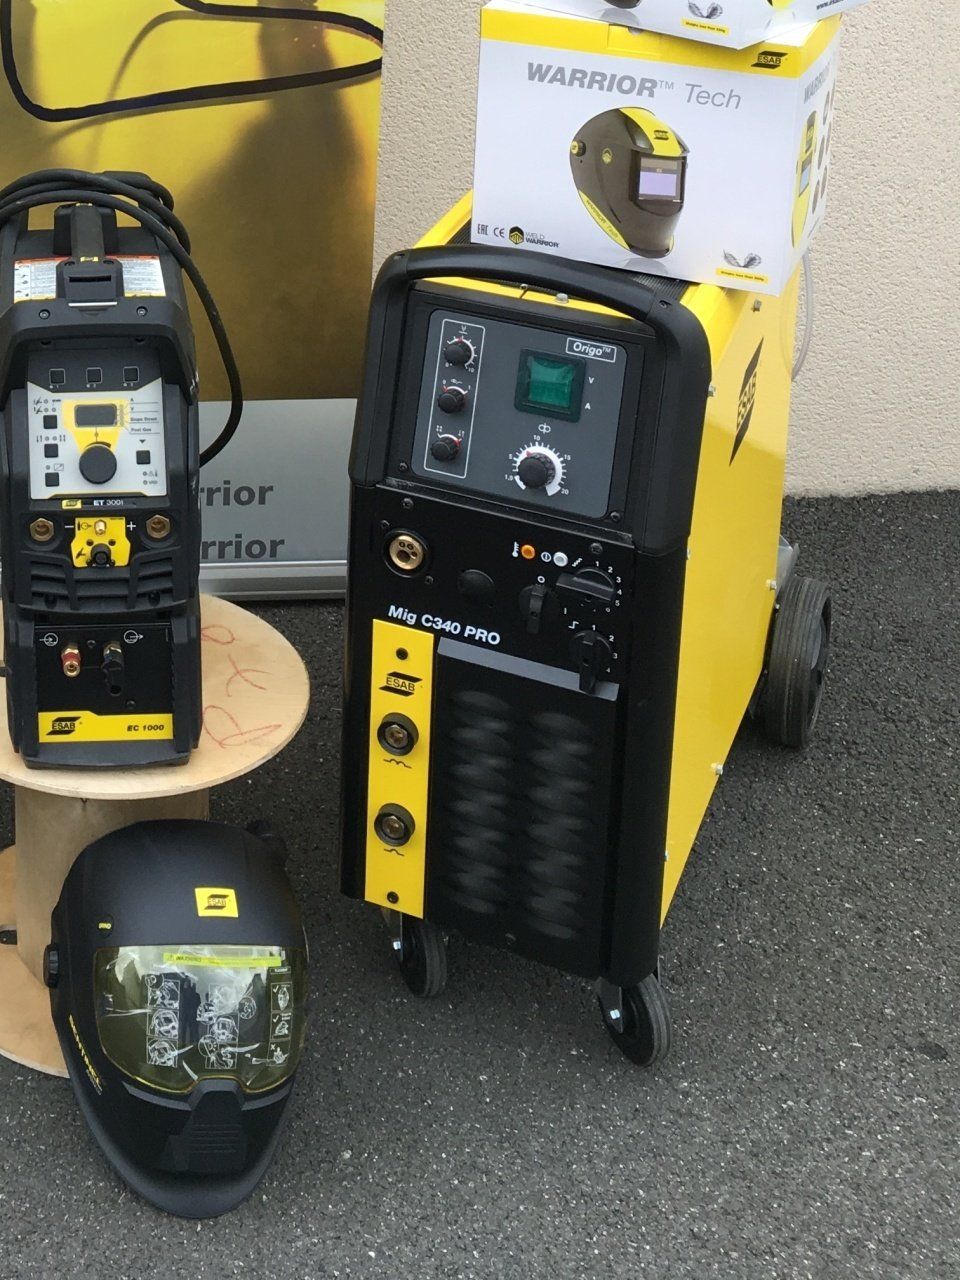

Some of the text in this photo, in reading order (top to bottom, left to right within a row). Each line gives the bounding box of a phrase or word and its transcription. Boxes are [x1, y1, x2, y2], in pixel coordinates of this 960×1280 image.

[757, 54, 782, 65] ESAB
[685, 82, 741, 110] Tech
[525, 237, 560, 249] WARRIOR
[560, 488, 570, 496] 20
[388, 604, 501, 646] Mig C340 PRO
[385, 675, 416, 693] ESAB
[51, 721, 165, 732] ESAB EC 1000
